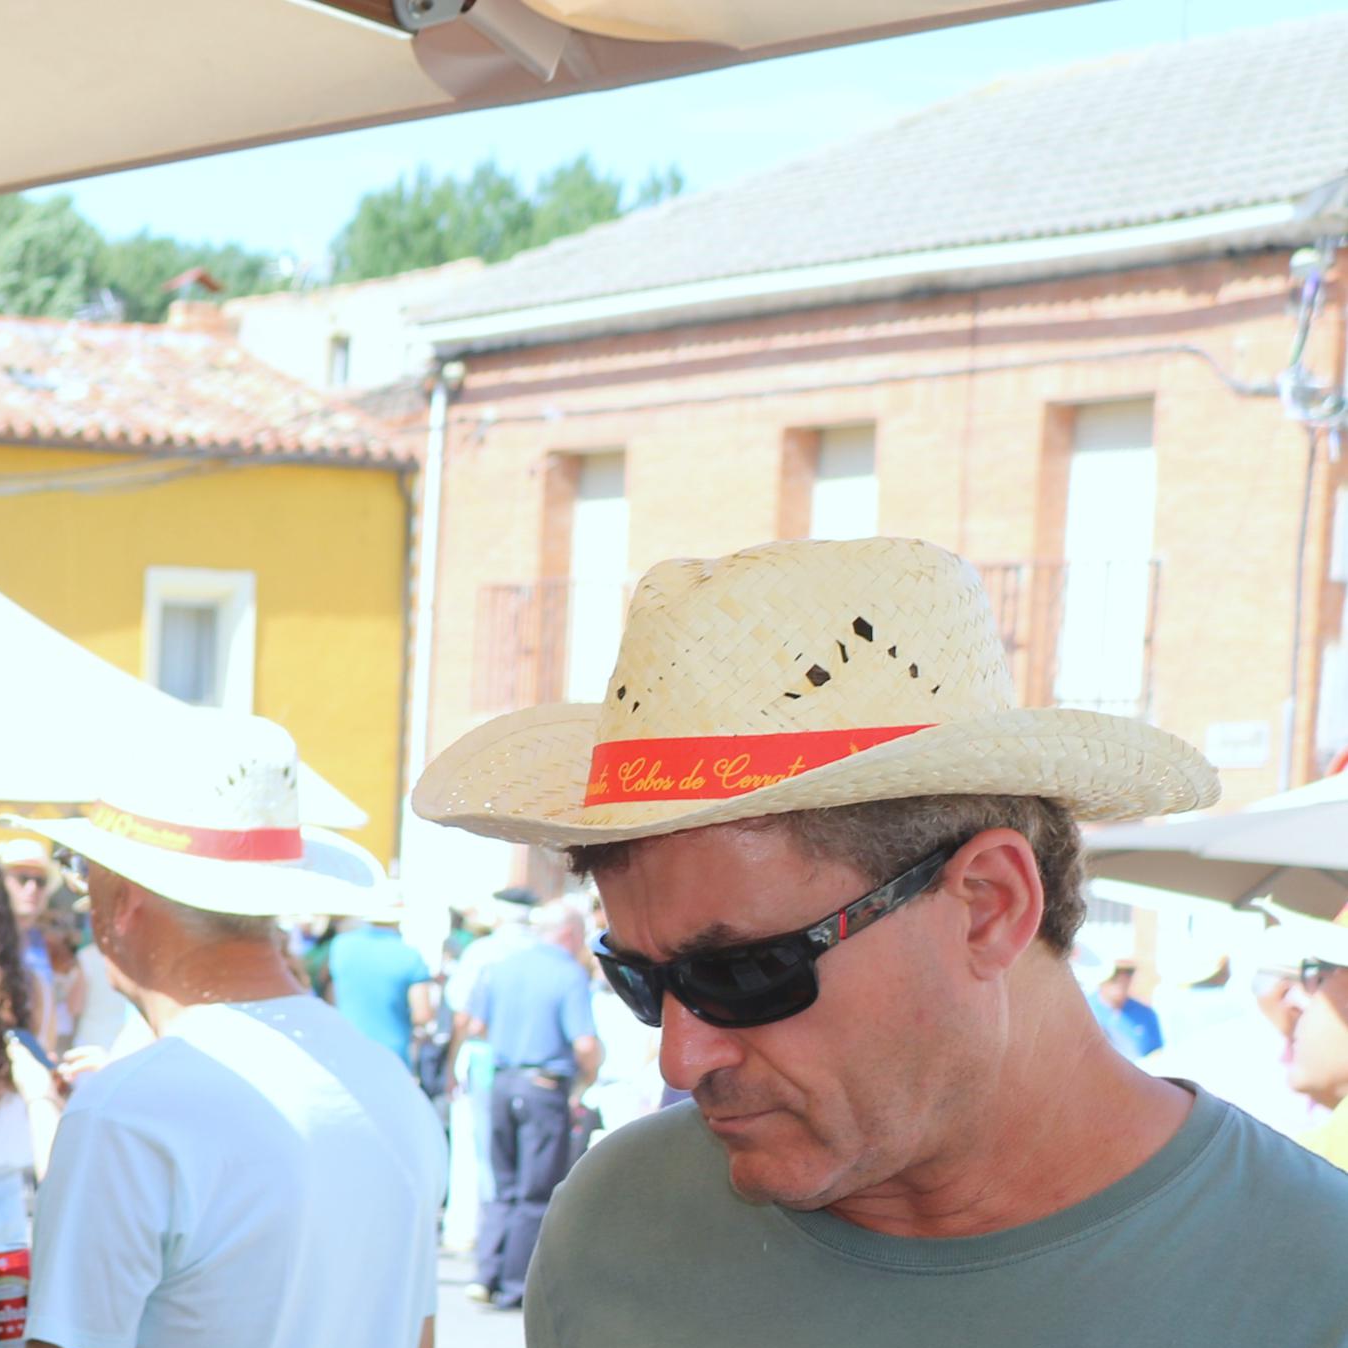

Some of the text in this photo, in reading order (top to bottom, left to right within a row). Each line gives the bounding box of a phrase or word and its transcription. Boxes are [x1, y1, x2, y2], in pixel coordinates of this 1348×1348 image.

[618, 757, 675, 792] Cobos
[679, 759, 706, 790] de
[713, 753, 806, 790] Cerrat
